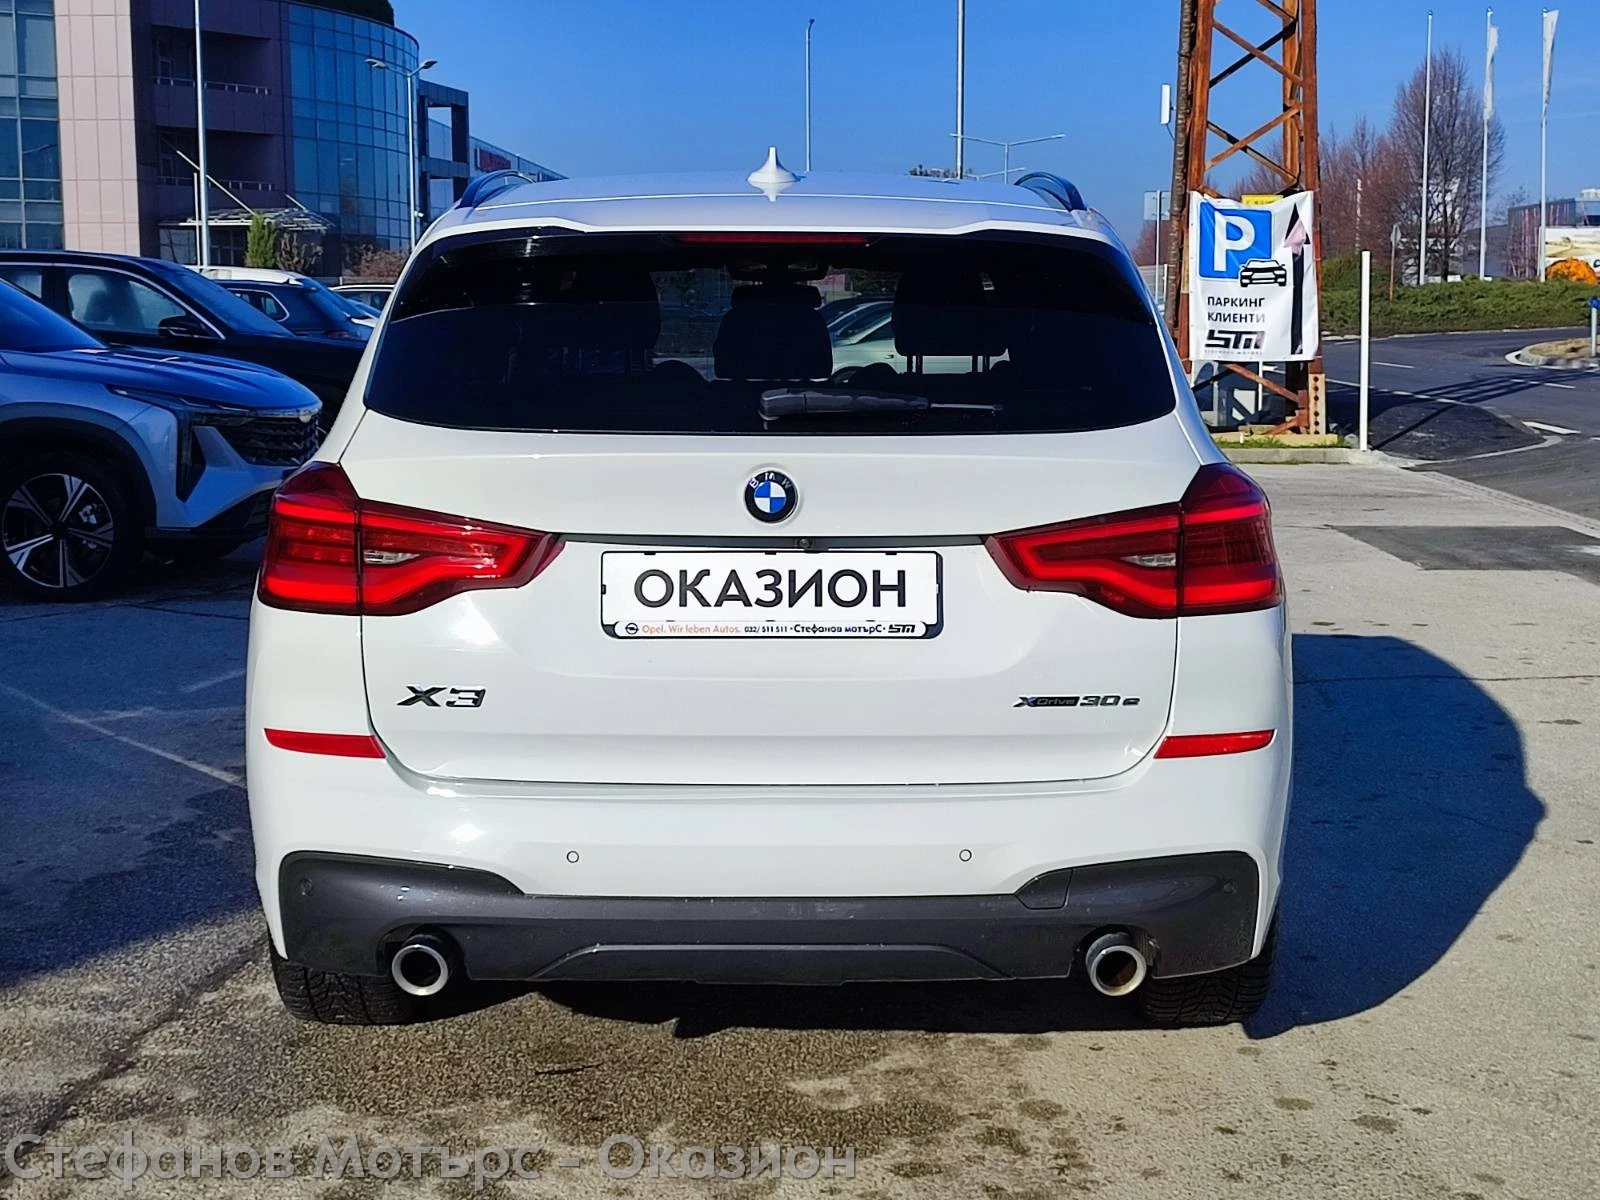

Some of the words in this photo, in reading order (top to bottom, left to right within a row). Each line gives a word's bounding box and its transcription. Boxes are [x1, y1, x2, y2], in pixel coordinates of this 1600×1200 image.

[1213, 211, 1255, 272] P
[1207, 296, 1266, 308] ПАРКИНГ
[1207, 312, 1266, 323] КЛИЕНТИ
[634, 569, 906, 608] ОКАЗИОН
[642, 625, 665, 635] Opel.
[668, 625, 684, 633] Wir
[685, 625, 711, 633] leben
[713, 625, 741, 633] Autos.
[397, 685, 486, 708] X3
